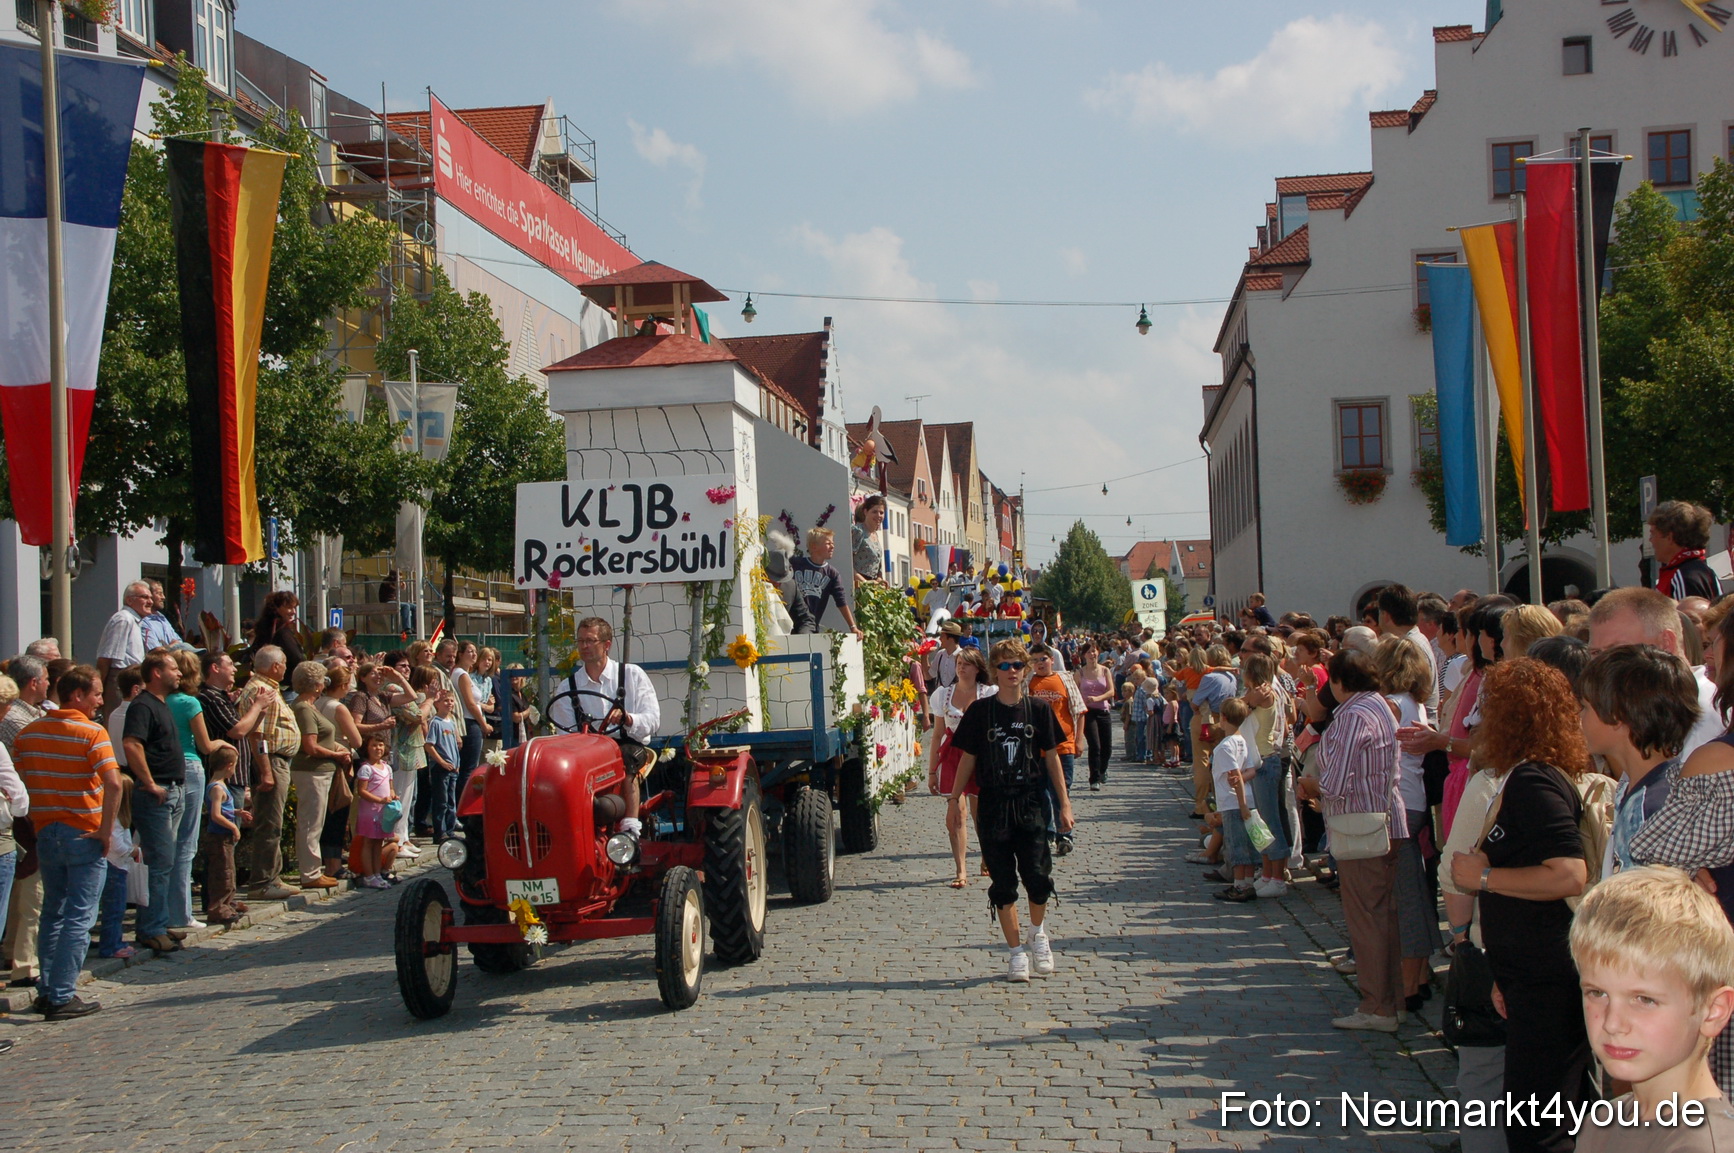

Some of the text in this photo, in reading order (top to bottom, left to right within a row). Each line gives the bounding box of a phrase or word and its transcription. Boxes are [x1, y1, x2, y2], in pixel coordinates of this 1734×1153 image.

[455, 162, 611, 281] Hier errichtet die Sparkasse Neumarkt
[561, 483, 678, 544] KLJB
[1643, 482, 1653, 515] P
[524, 530, 727, 582] Röckersbühl
[522, 880, 544, 892] NM
[540, 892, 554, 903] 15
